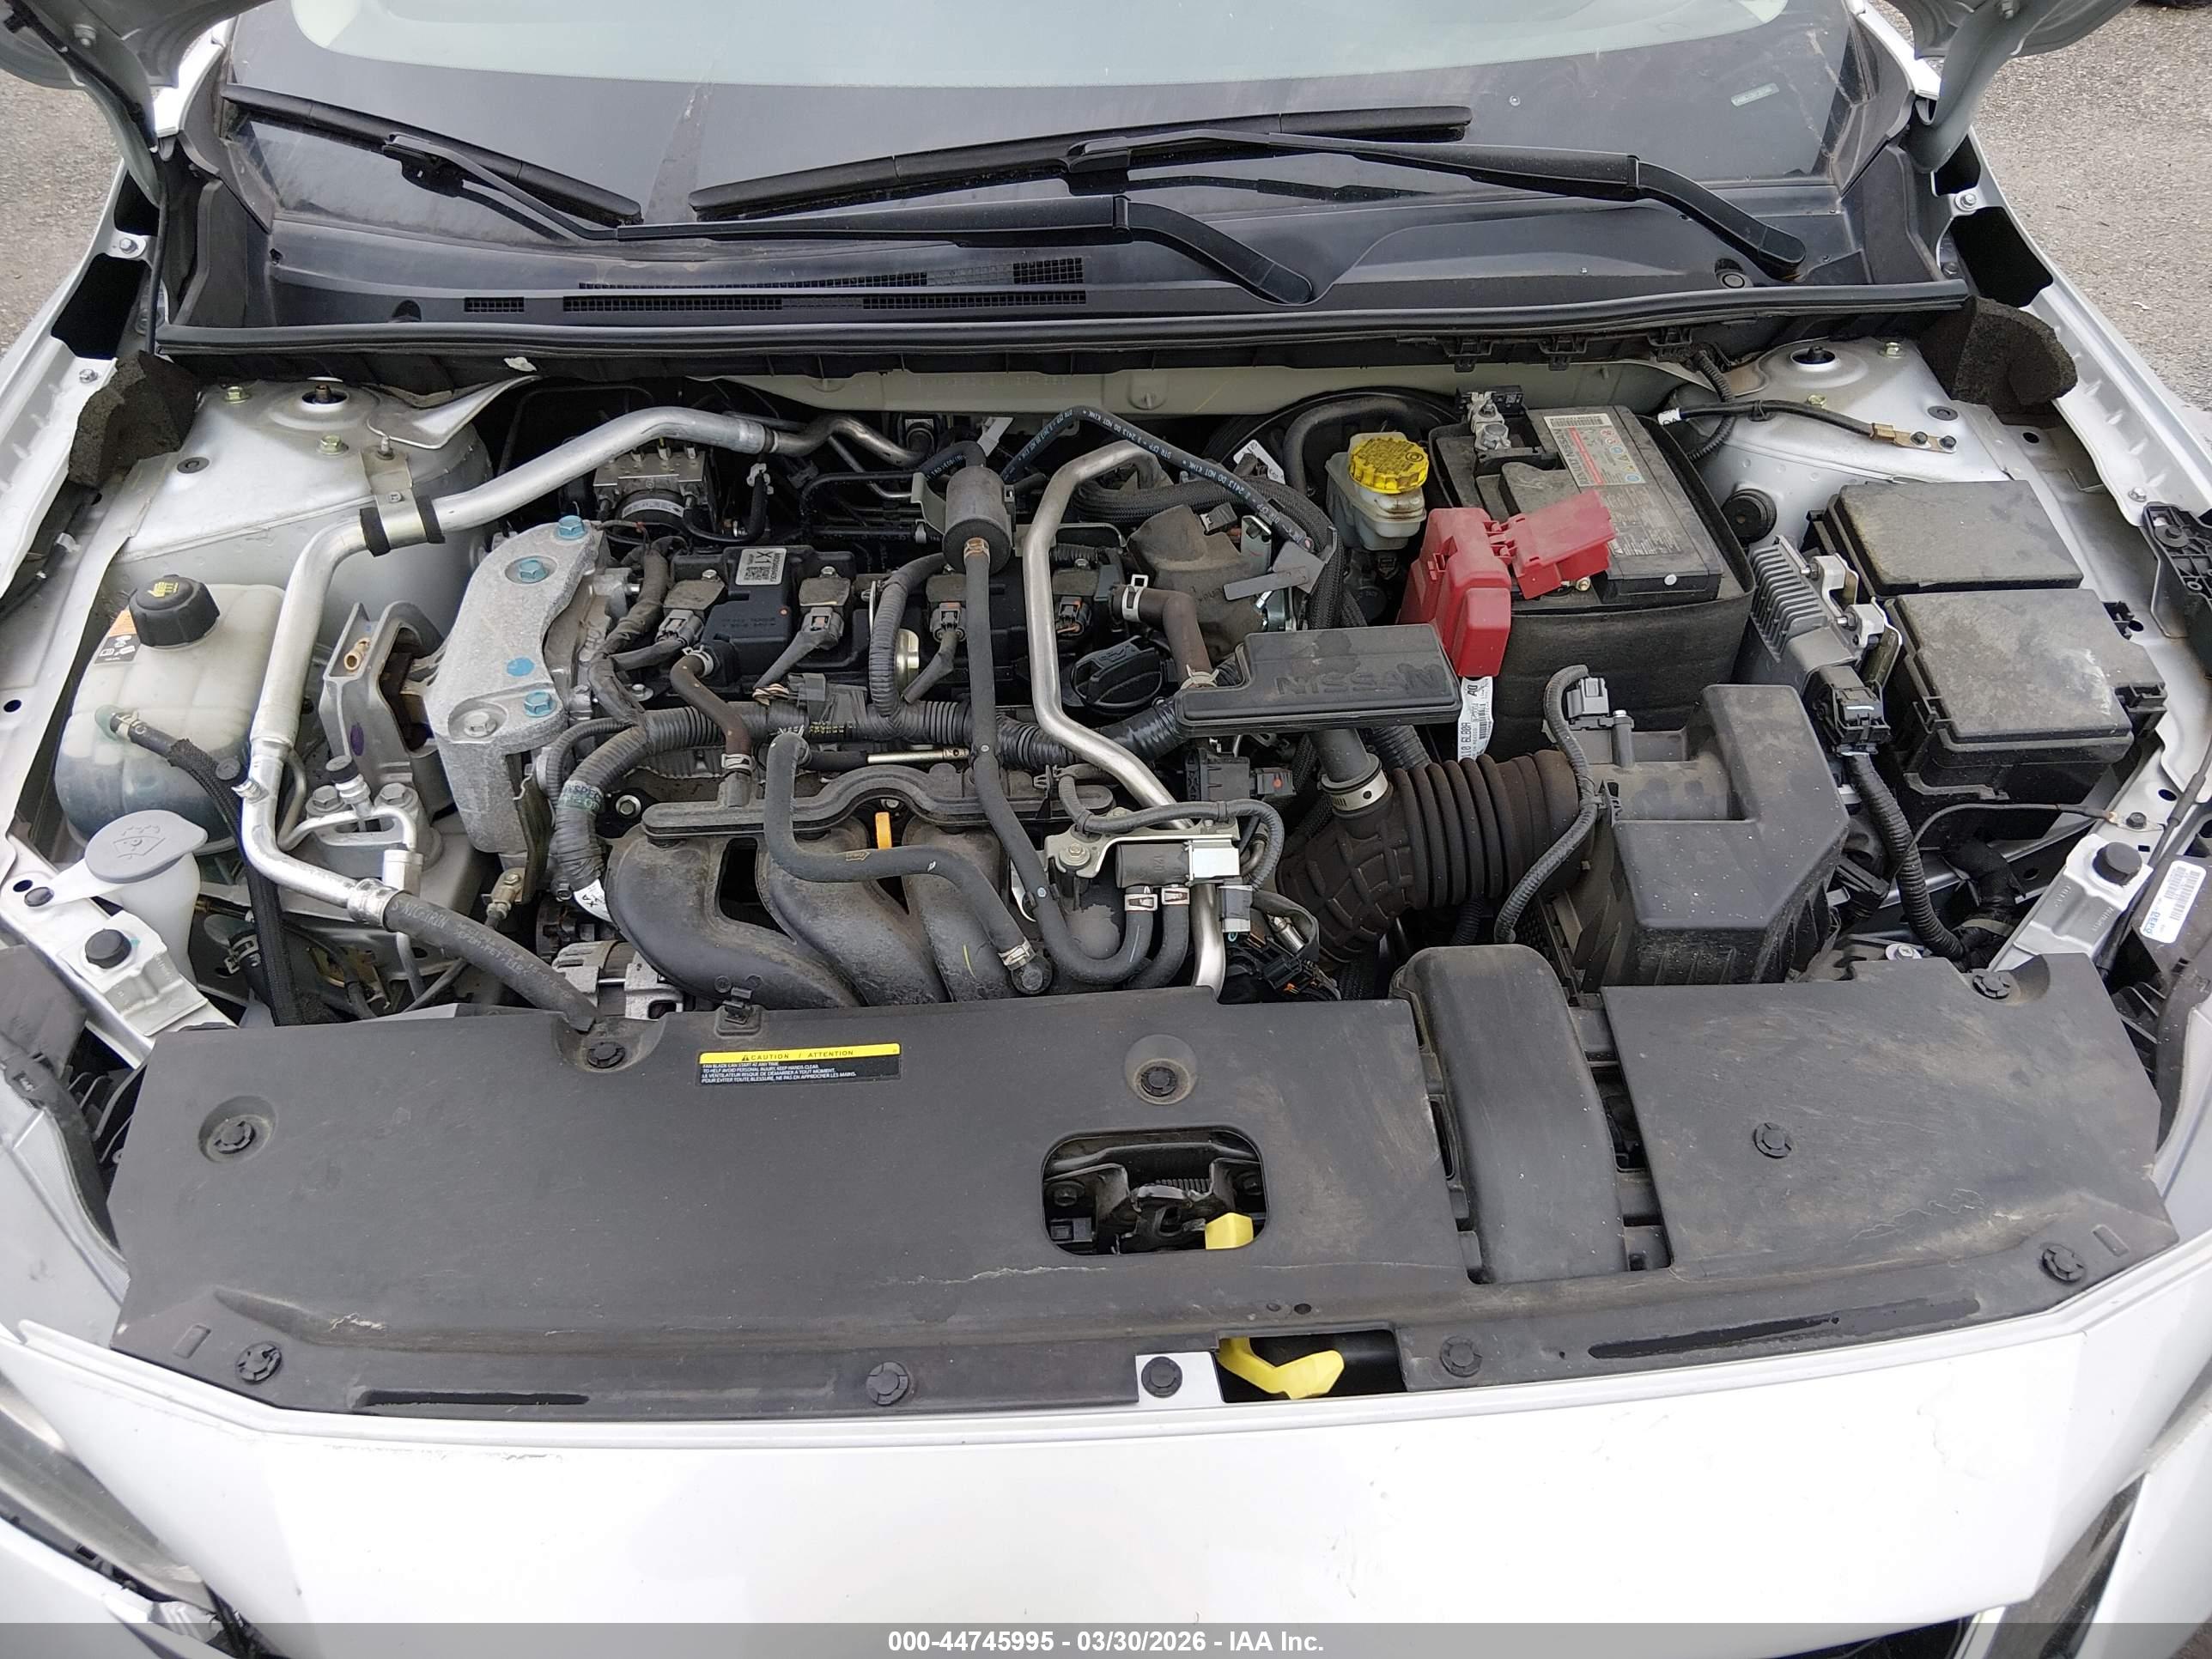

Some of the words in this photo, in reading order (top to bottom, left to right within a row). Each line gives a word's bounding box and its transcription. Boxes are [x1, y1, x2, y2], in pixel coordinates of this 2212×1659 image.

[1088, 410, 1102, 422] KINK
[1103, 418, 1113, 428] NOT
[1114, 424, 1121, 433] DO
[1188, 461, 1202, 473] KINK
[1204, 468, 1216, 478] NOT
[1218, 474, 1227, 483] DO
[1228, 480, 1244, 494] 2413
[756, 551, 773, 563] X1
[1275, 665, 1452, 695] NISSAN
